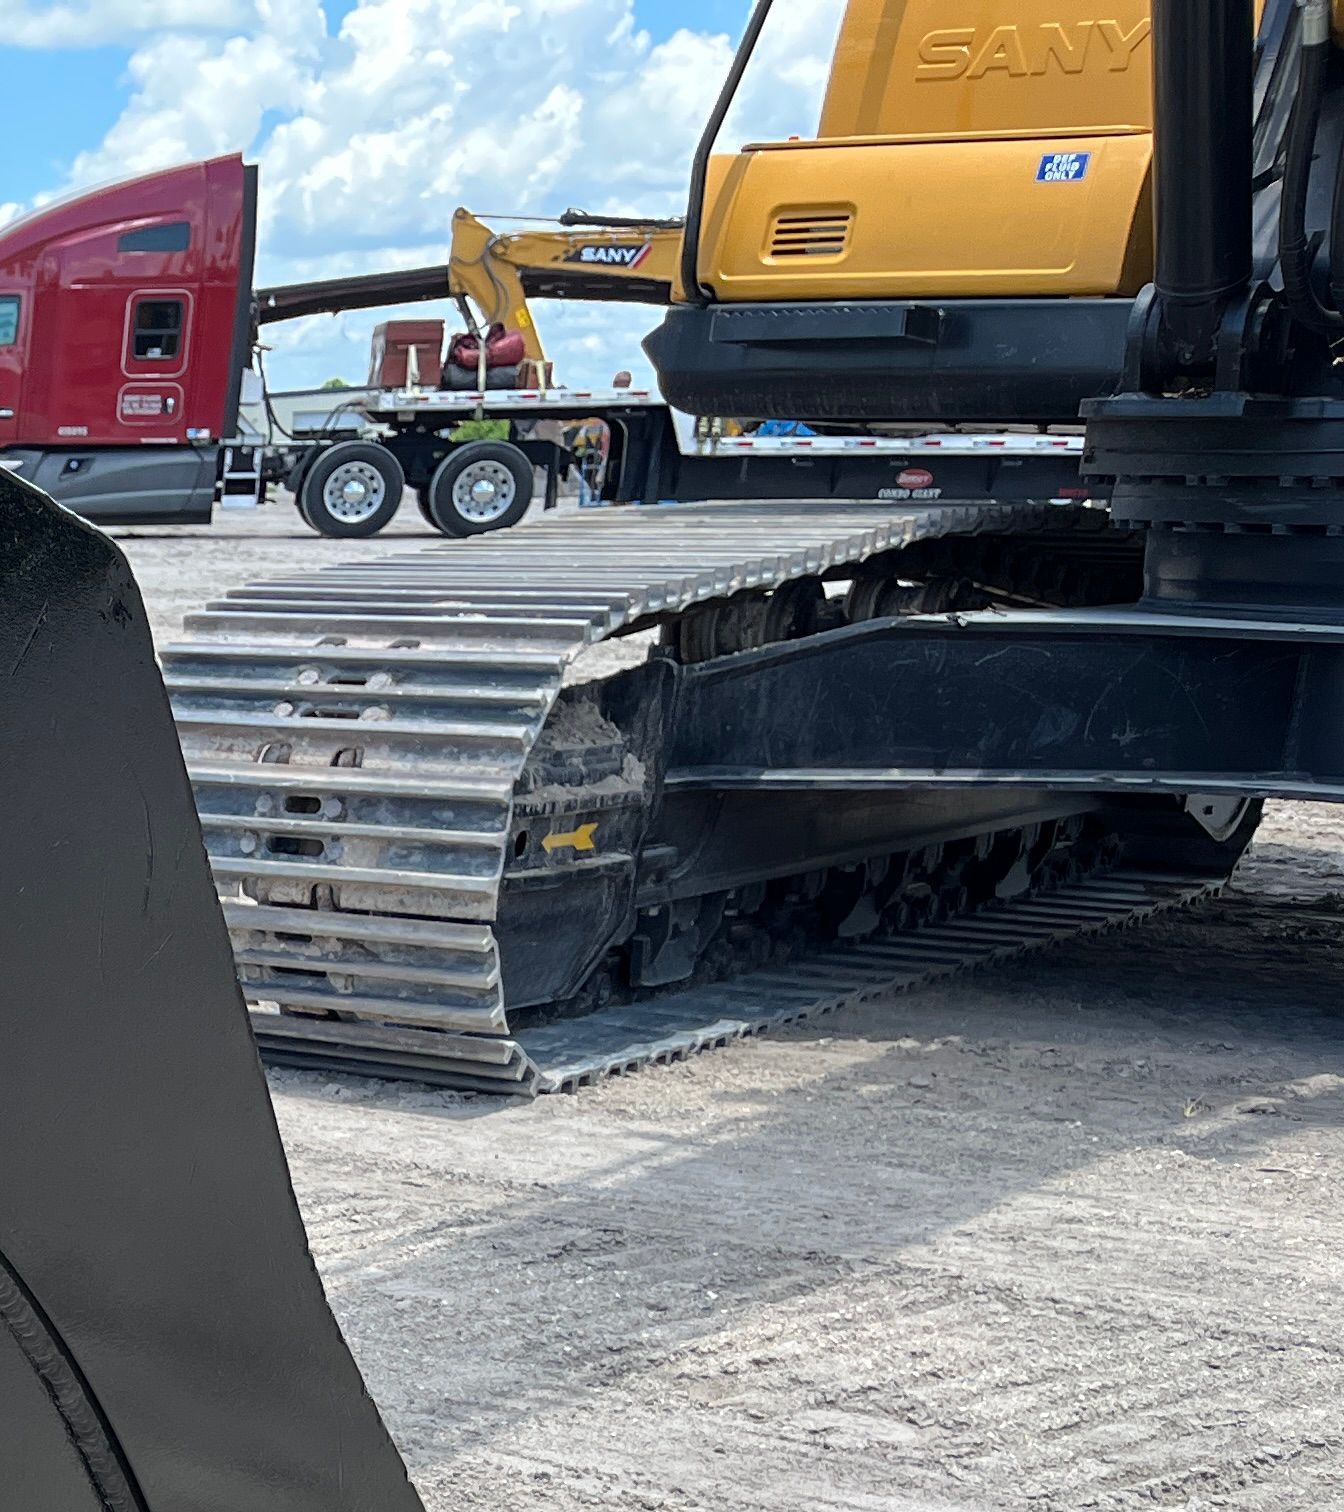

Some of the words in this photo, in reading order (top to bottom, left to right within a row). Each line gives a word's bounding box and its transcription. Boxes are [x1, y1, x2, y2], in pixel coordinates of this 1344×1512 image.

[915, 18, 1151, 83] SANY
[1045, 161, 1080, 172] FLUID
[1044, 170, 1075, 180] ONLY
[580, 247, 636, 262] SANY
